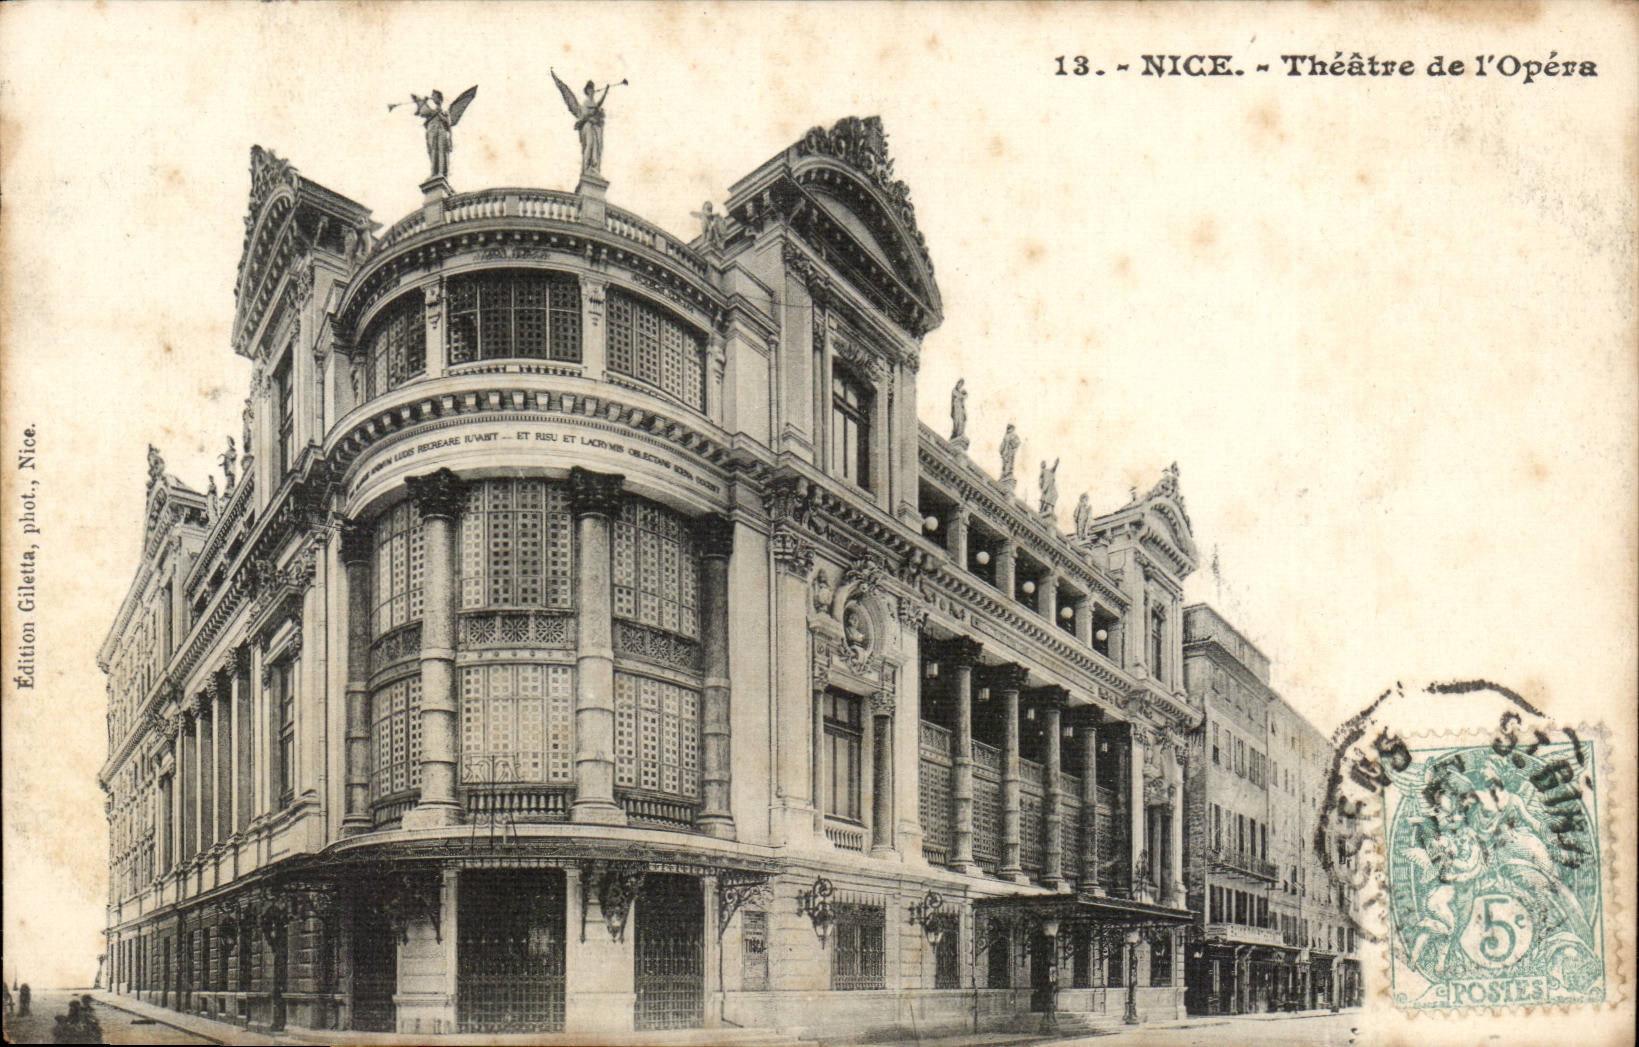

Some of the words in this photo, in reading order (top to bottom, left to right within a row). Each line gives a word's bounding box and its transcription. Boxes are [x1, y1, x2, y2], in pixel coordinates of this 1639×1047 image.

[417, 437, 460, 453] RECREARE
[516, 432, 530, 441] ET
[535, 432, 558, 442] RISU
[562, 435, 577, 443] ET
[1452, 979, 1543, 1004] POSTES
